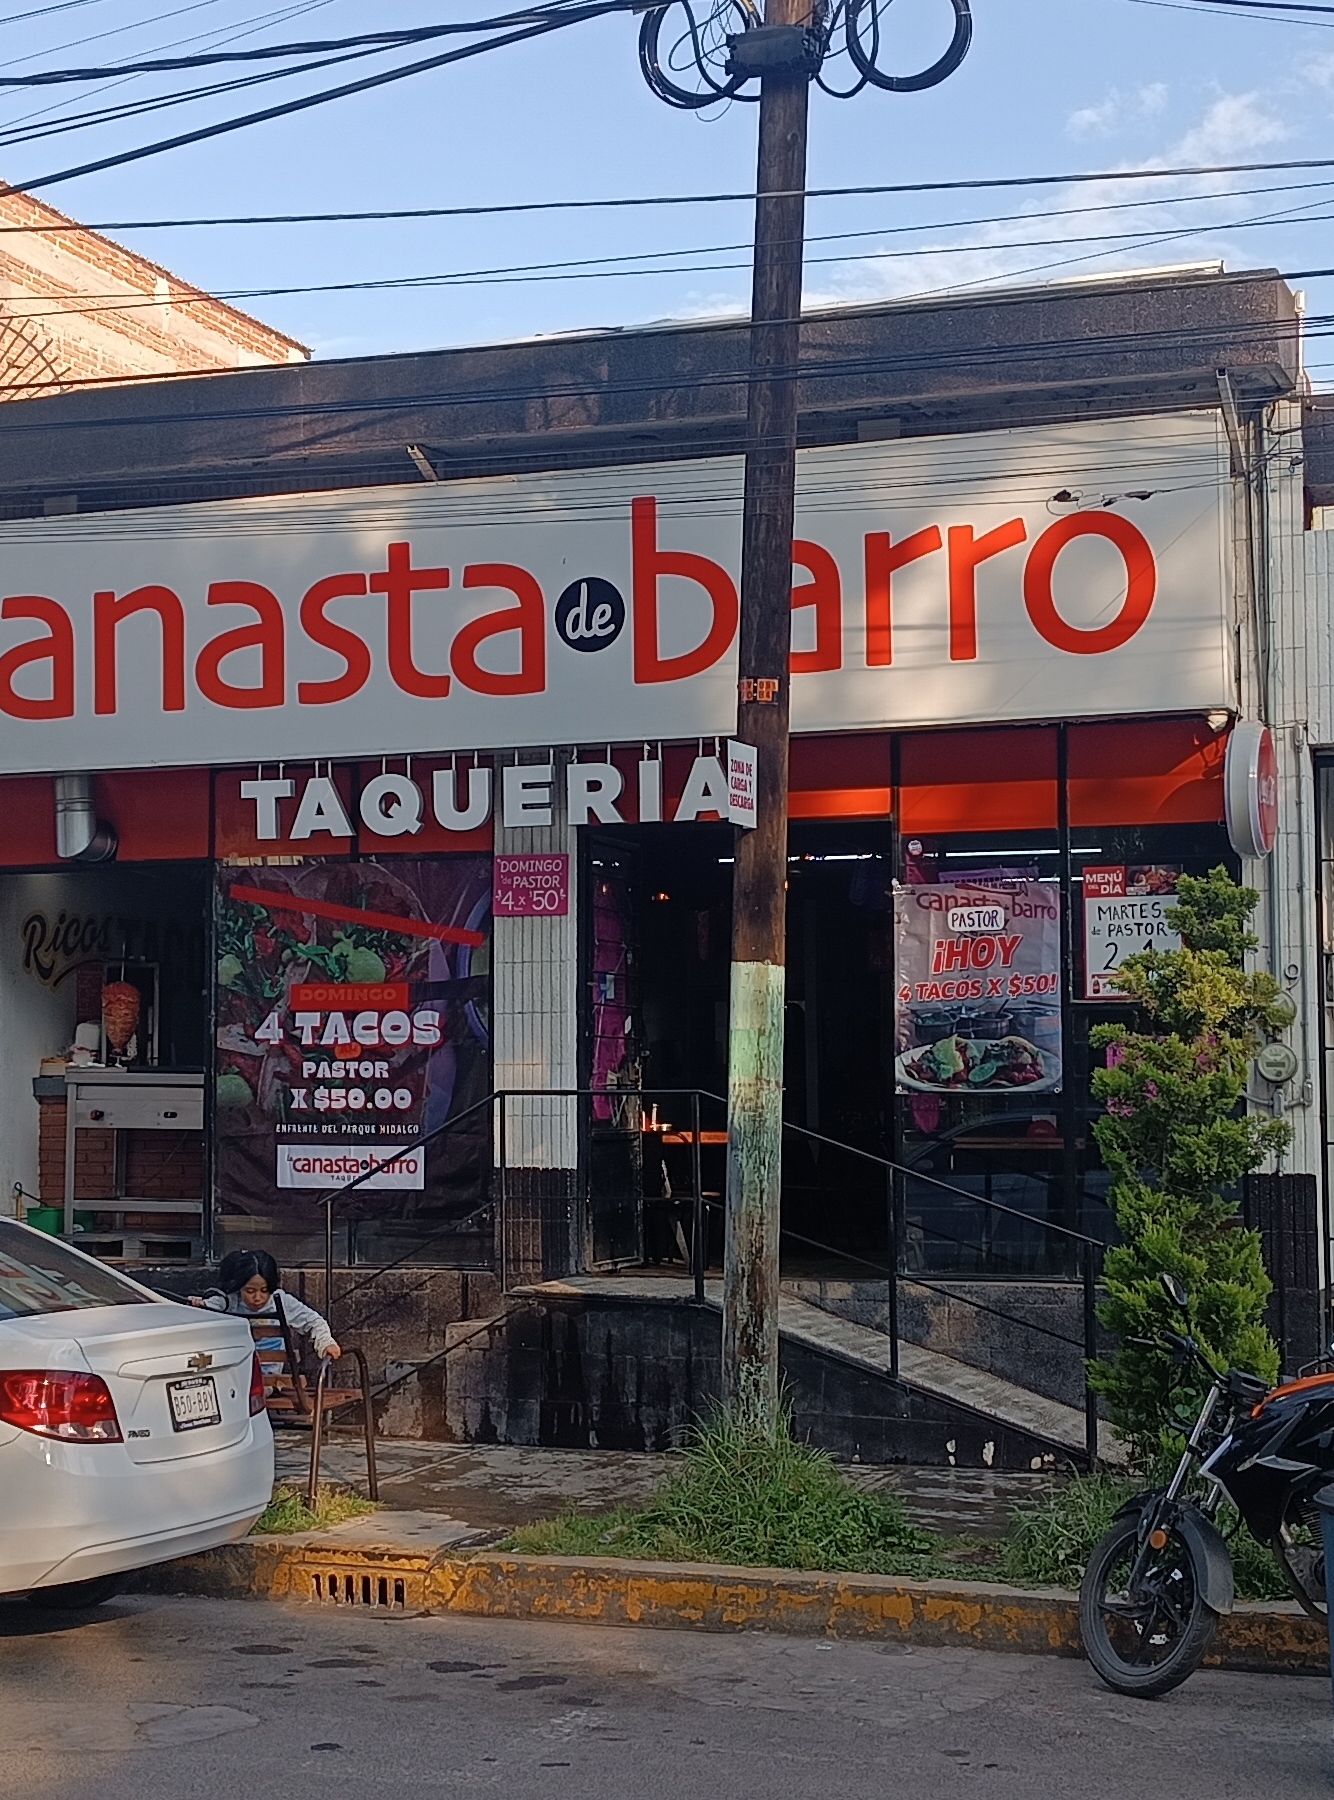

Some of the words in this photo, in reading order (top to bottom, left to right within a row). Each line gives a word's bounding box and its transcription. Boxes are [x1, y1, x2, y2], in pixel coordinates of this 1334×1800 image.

[566, 582, 616, 638] de
[631, 495, 1157, 684] barro
[730, 758, 745, 775] ZONA
[746, 760, 753, 777] DE
[730, 776, 748, 794] CARGA
[749, 781, 752, 793] Y
[240, 755, 730, 841] TAQUERIA
[729, 793, 754, 812] DESCARGA
[499, 859, 563, 873] DOMINGO
[512, 875, 561, 889] PASTOR
[1085, 870, 1123, 883] MENÚ
[1100, 881, 1123, 895] DÍA
[500, 890, 515, 911] 4
[1011, 895, 1058, 920] barro
[951, 909, 1000, 929] PASTOR
[1097, 901, 1162, 921] MARTES
[1108, 921, 1168, 937] PASTOR
[22, 910, 112, 981] Ricos
[932, 934, 1022, 974] ¡HOY
[299, 987, 398, 1001] DOMINGO
[898, 983, 912, 1003] 4
[915, 977, 982, 1002] TACOS
[986, 976, 1004, 996] X
[1007, 973, 1057, 998] $50!
[254, 1010, 284, 1045] 4
[293, 1009, 442, 1046] TACOS
[301, 1060, 390, 1079] PASTOR
[289, 1087, 309, 1110] X
[312, 1085, 413, 1112] $50.00
[275, 1123, 318, 1134] ENFRENTE
[321, 1124, 338, 1134] DEL
[341, 1124, 376, 1135] PARQUE
[379, 1124, 419, 1134] HIDALGO
[292, 1154, 360, 1174] canasta
